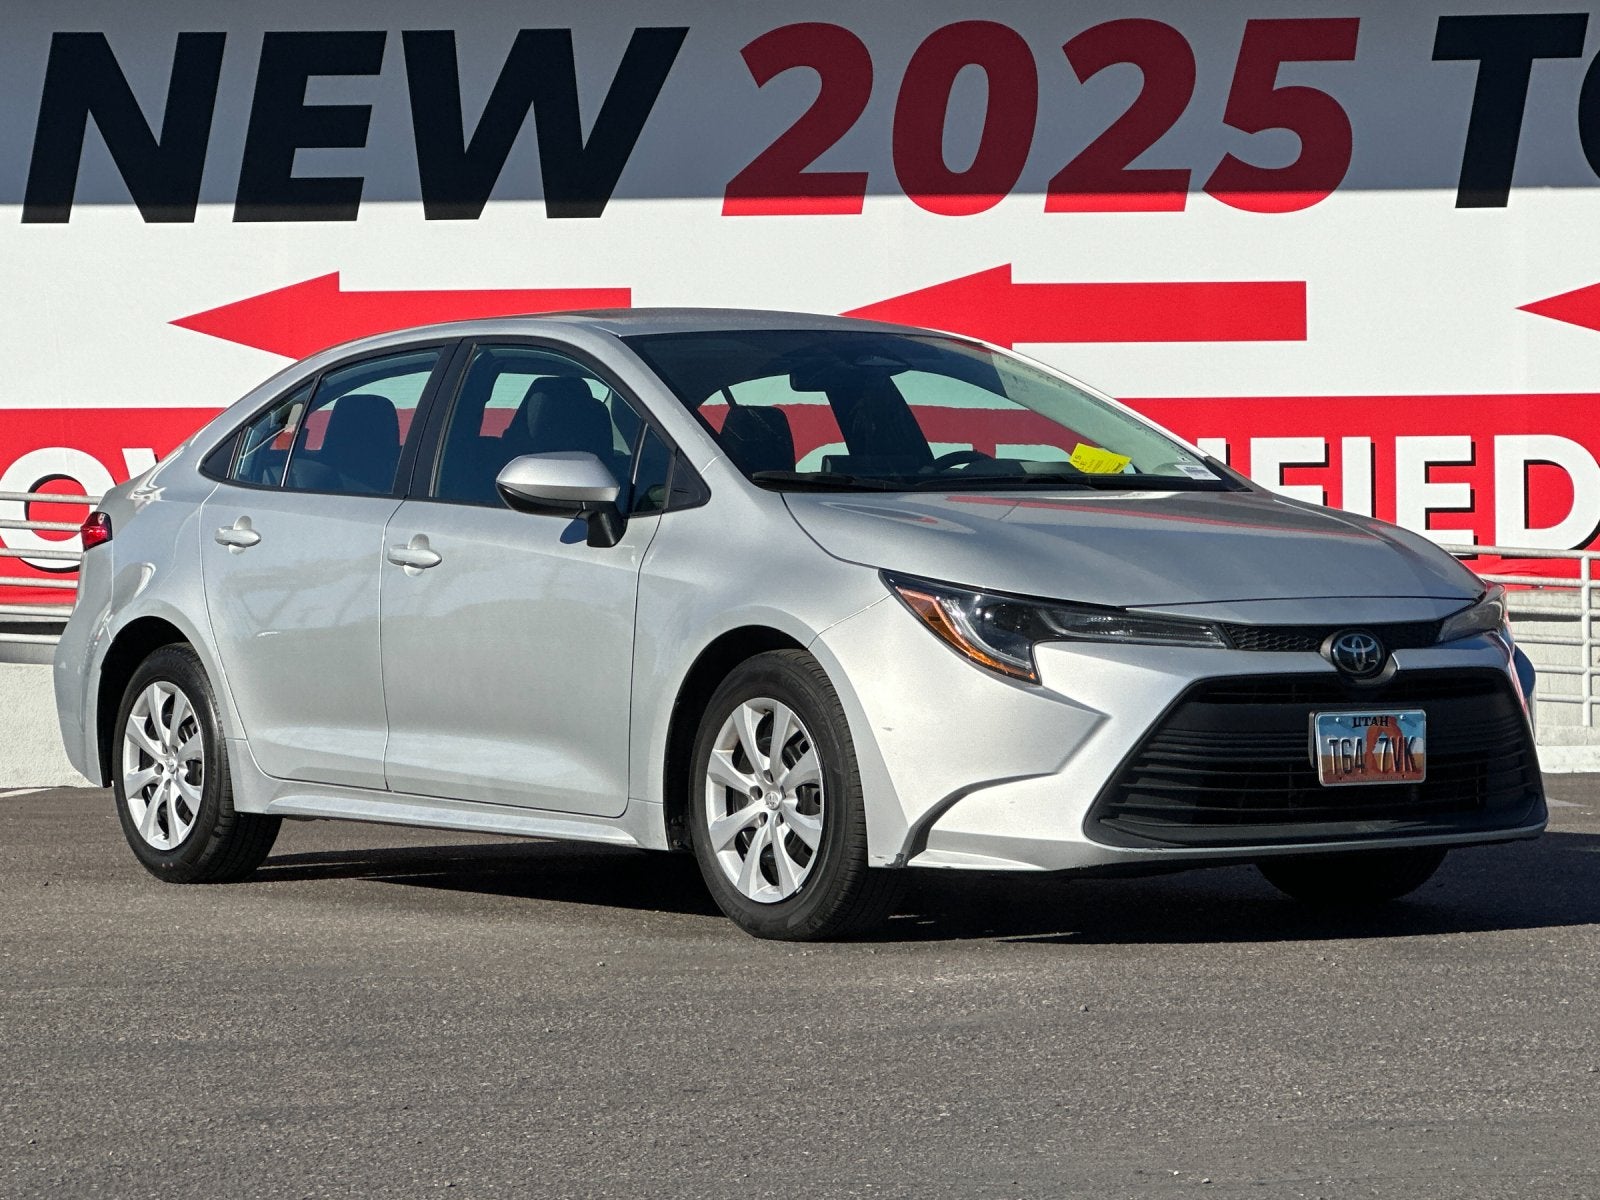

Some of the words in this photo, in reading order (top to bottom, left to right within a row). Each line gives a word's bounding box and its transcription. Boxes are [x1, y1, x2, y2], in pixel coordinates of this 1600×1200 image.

[21, 27, 690, 223] NEW
[722, 18, 1360, 216] 2025
[1432, 13, 1600, 208] T
[1352, 716, 1389, 728] UTAH
[1379, 736, 1417, 773] 7VK
